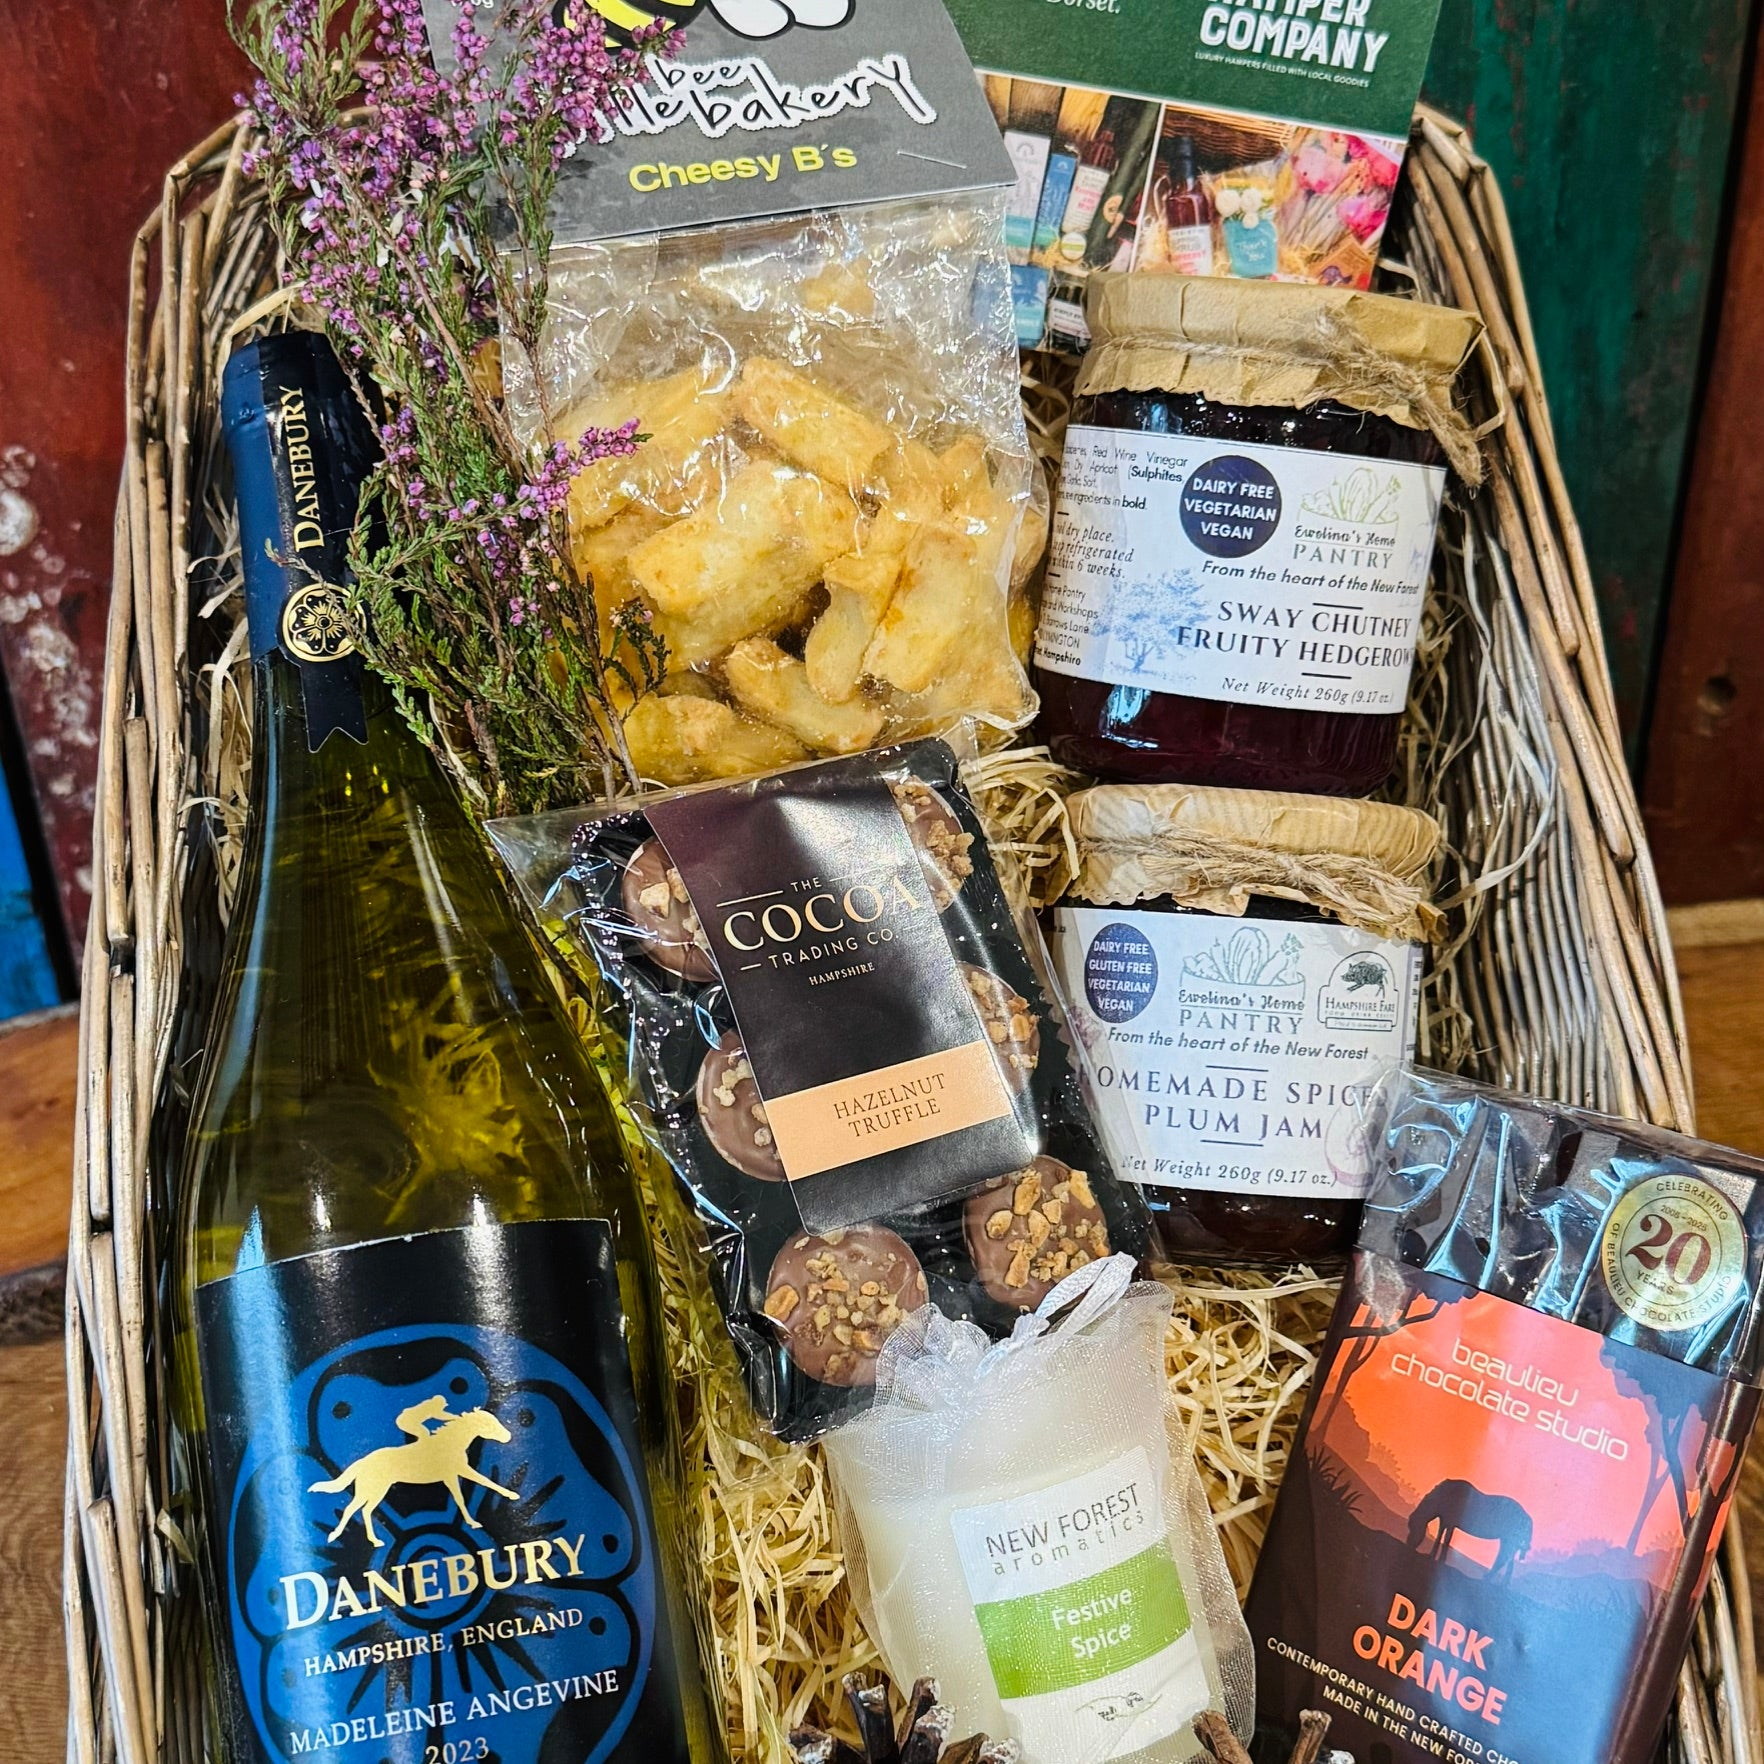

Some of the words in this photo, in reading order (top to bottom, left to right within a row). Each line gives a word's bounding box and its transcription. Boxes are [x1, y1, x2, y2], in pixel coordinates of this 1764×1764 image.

[1199, 4, 1389, 73] COMPANY
[655, 59, 741, 89] bee
[1195, 52, 1224, 64] LUXURY
[1262, 63, 1287, 75] FILLED
[1288, 67, 1306, 77] WITH
[1308, 71, 1332, 83] LOCAL
[1333, 75, 1370, 89] GOODIES
[628, 152, 780, 193] Cheesy
[279, 384, 325, 553] DANEBURY
[1115, 447, 1137, 462] Wine
[1146, 450, 1189, 470] Vinegar
[1192, 477, 1238, 495] DAIRY
[1239, 482, 1275, 499] FREE
[1184, 498, 1277, 522] VEGETARIAN
[1082, 525, 1115, 543] place.
[1200, 521, 1254, 540] VEGAN
[1065, 540, 1135, 563] refrigerated
[1077, 559, 1085, 573] 6
[1087, 562, 1126, 579] weeks.
[1292, 543, 1393, 569] PANTRY
[1202, 560, 1245, 578] From
[1249, 565, 1277, 581] the
[1281, 569, 1325, 587] heart
[1328, 574, 1347, 589] of
[1346, 576, 1369, 592] the
[1370, 578, 1396, 594] New
[1069, 620, 1090, 635] Lane
[1217, 600, 1304, 629] SWAY
[1312, 611, 1413, 638] CHUTNEY
[1176, 625, 1291, 658] FRUITY
[1221, 677, 1249, 693] Net
[1256, 681, 1310, 701] Weight
[1314, 687, 1349, 705] 260g
[1351, 689, 1378, 705] (9.17
[791, 876, 822, 893] THE
[723, 876, 920, 951] COCOA
[768, 937, 859, 969] TRADING
[866, 927, 899, 946] CO.
[1093, 940, 1123, 954] DAIRY
[1123, 942, 1150, 955] FREE
[808, 961, 876, 986] HAMPSHIRE
[1088, 977, 1151, 993] VEGETARIAN
[1089, 958, 1125, 973] GLUTEN
[1126, 961, 1153, 975] FREE
[1098, 996, 1134, 1012] VEGAN
[1179, 1008, 1304, 1035] PANTRY
[1325, 997, 1377, 1012] HAMPSHIRE
[1108, 1027, 1143, 1044] From
[1148, 1030, 1174, 1047] the
[1178, 1032, 1226, 1051] heart
[1230, 1037, 1251, 1053] of
[1253, 1038, 1281, 1056] the
[1285, 1041, 1323, 1058] New
[1324, 1043, 1369, 1061] Forest
[833, 1072, 947, 1120] HAZELNUT
[848, 1097, 942, 1138] TRUFFLE
[1144, 1103, 1240, 1134] PLUM
[1258, 1113, 1323, 1141] JAM
[1121, 1154, 1147, 1171] Net
[1153, 1157, 1212, 1179] Weight
[1218, 1164, 1262, 1185] 260g
[1267, 1167, 1308, 1186] (9.17
[1311, 1170, 1338, 1188] oz.)
[1656, 1181, 1728, 1221] CELEBRATING
[1610, 1222, 1621, 1240] OF
[1625, 1213, 1712, 1286] 20
[1607, 1243, 1626, 1296] BEAULIEU
[1452, 1337, 1580, 1407] beaulieu
[1391, 1352, 1530, 1423] chocolate
[1535, 1408, 1629, 1462] studio
[986, 1521, 1049, 1558] NEW
[1057, 1482, 1140, 1538] FOREST
[994, 1513, 1145, 1576] aromatics
[279, 1533, 587, 1631] DANEBURY
[1051, 1585, 1133, 1631] Festive
[304, 1632, 454, 1678] HAMPSHIRE,
[462, 1607, 584, 1648] ENGLAND
[1070, 1621, 1133, 1660] Spice
[1387, 1592, 1495, 1672] DARK
[1352, 1624, 1508, 1726] ORANGE
[290, 1700, 457, 1755] MADELEINE
[466, 1668, 620, 1721] ANGEVINE
[1266, 1636, 1374, 1700] CONTEMPORARY
[1376, 1692, 1416, 1722] HAND
[1418, 1714, 1483, 1756] CRAFTED
[1322, 1684, 1361, 1716] MADE
[1363, 1706, 1380, 1725] IN
[1382, 1714, 1408, 1739] THE
[1410, 1729, 1444, 1758] NEW
[425, 1736, 490, 1764] 2023
